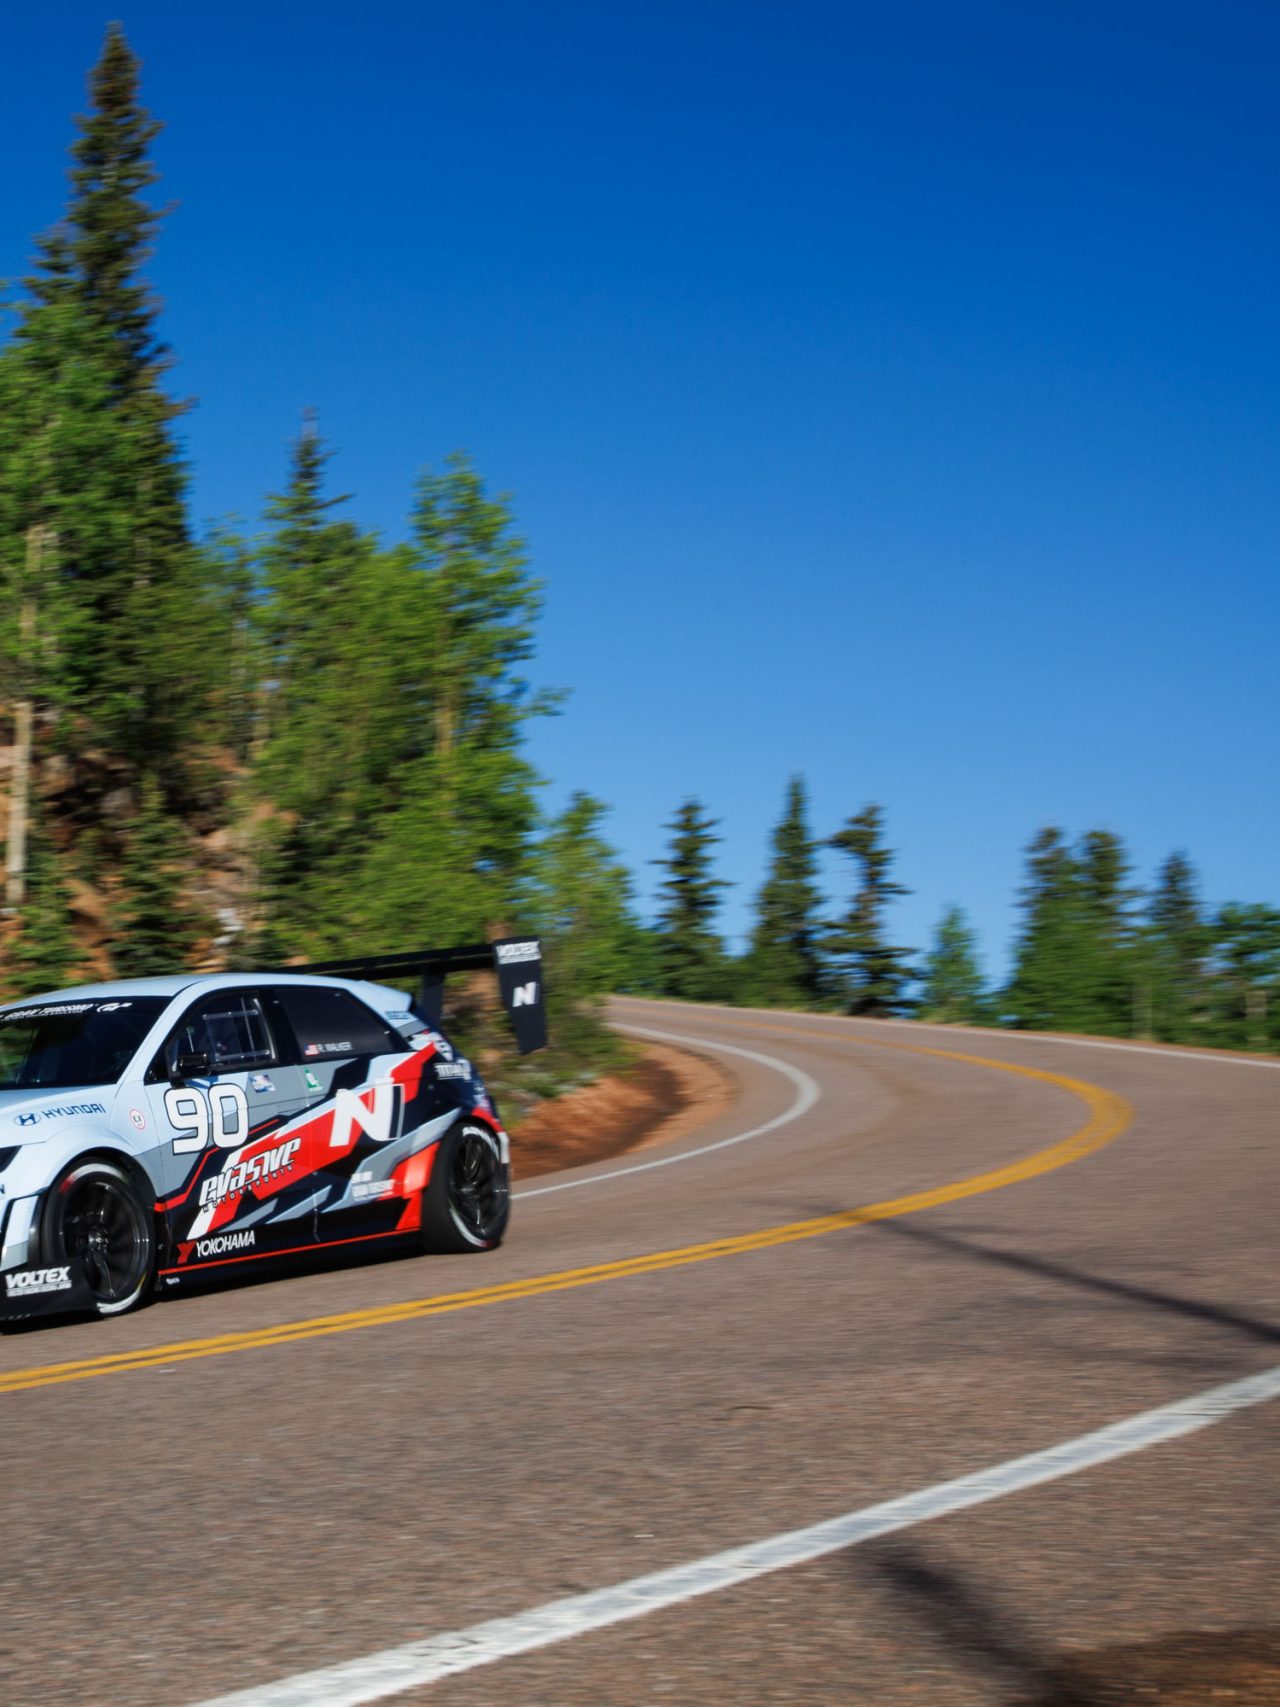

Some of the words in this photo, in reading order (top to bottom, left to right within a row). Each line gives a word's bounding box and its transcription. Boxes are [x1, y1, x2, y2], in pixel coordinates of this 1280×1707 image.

[41, 1103, 106, 1119] HYUNDAI
[164, 1083, 249, 1155] 90
[196, 1230, 255, 1257] YOKOHAMA
[5, 1266, 70, 1289] VOLTEX
